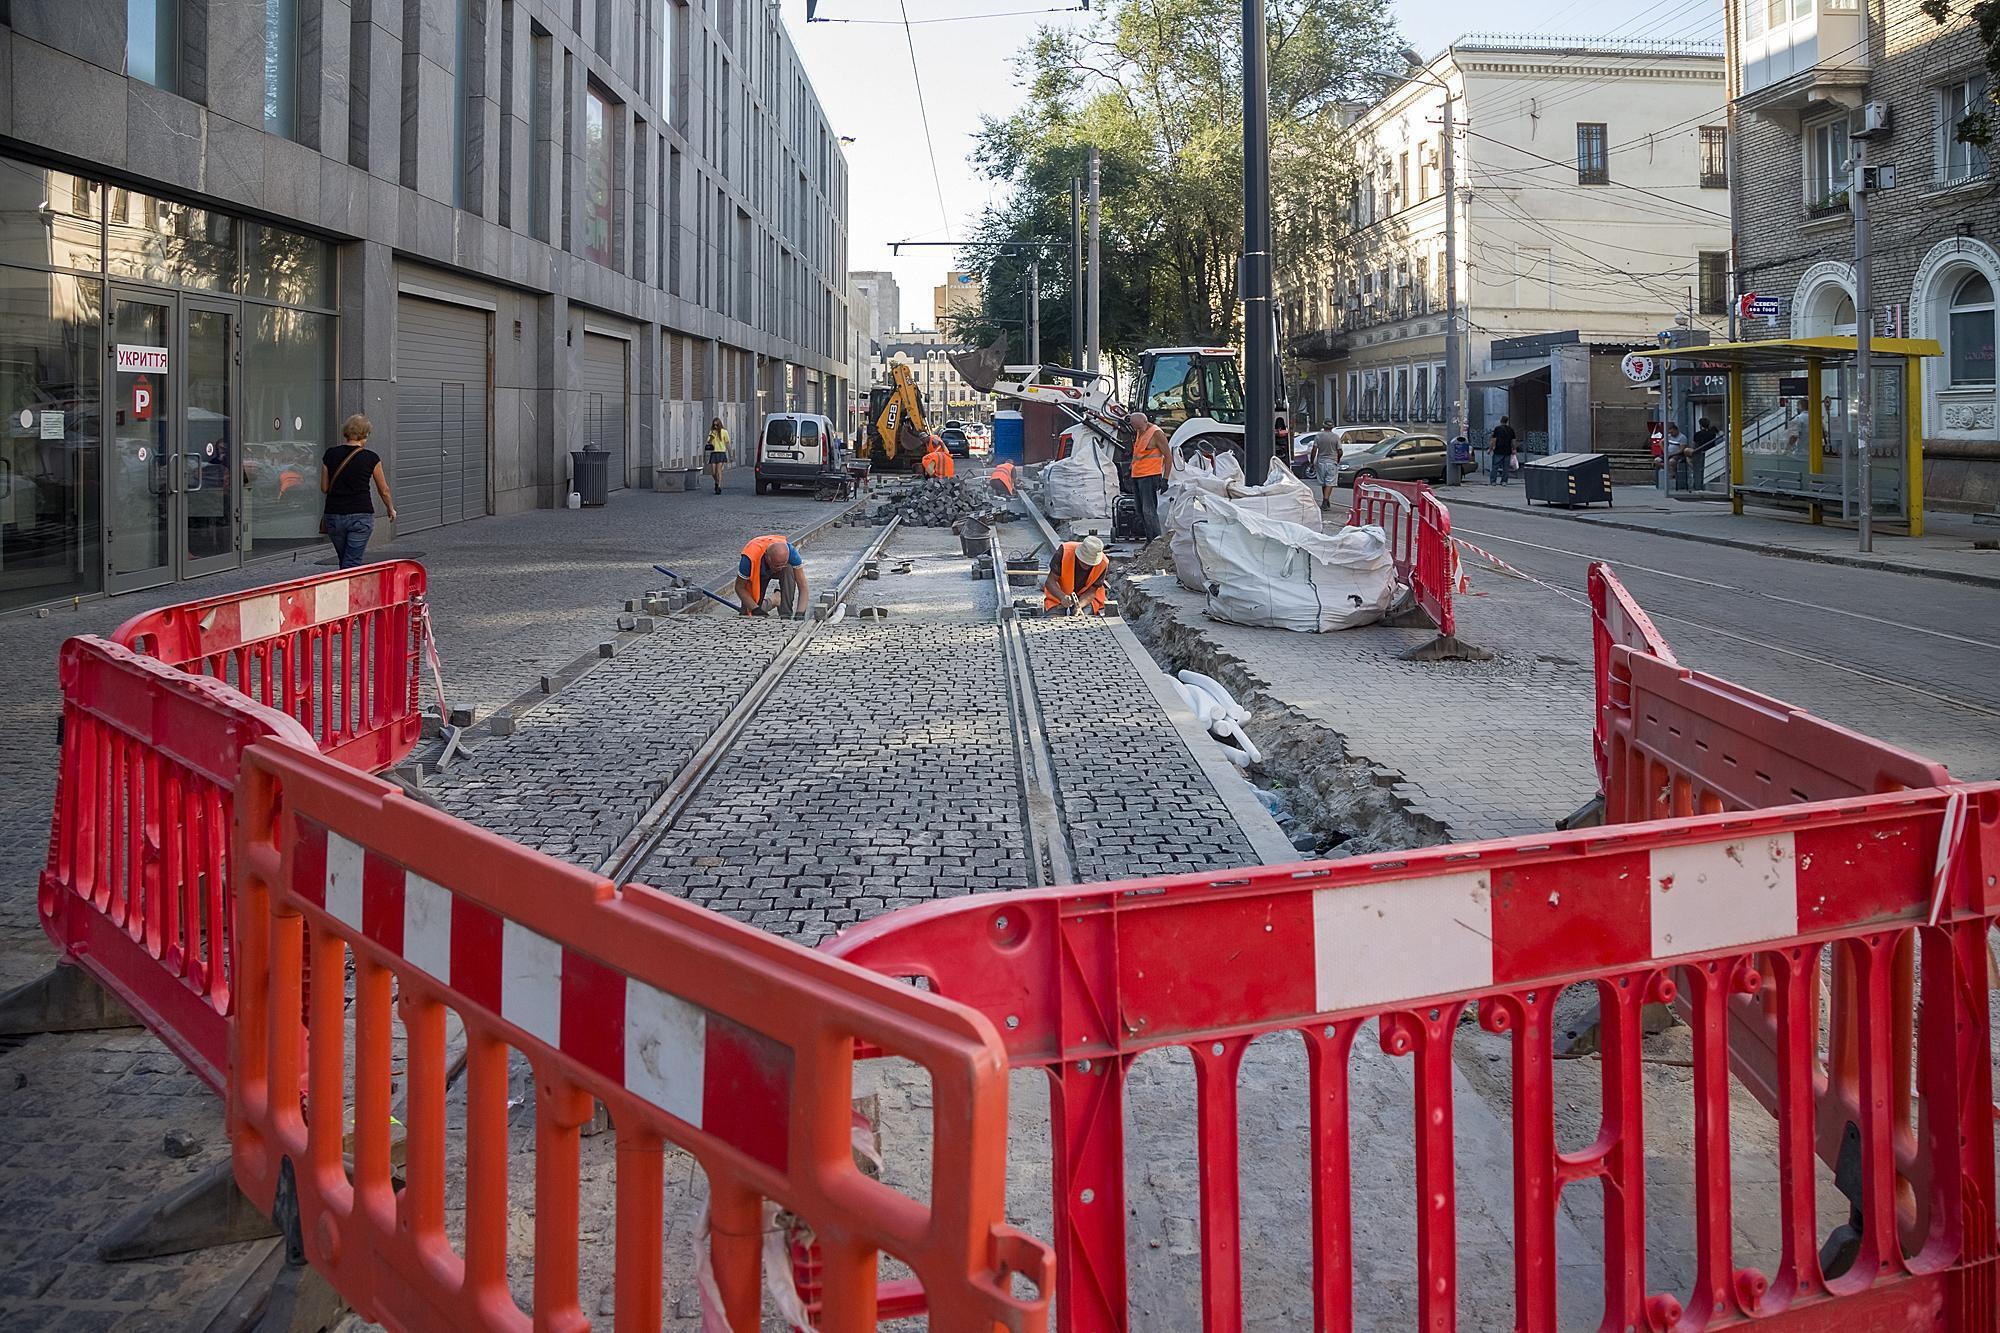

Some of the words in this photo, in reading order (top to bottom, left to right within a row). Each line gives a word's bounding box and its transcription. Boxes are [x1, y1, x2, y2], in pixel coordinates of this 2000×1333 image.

[118, 350, 167, 367] УКРИТТЯ
[135, 389, 150, 413] P
[887, 404, 898, 429] JCB
